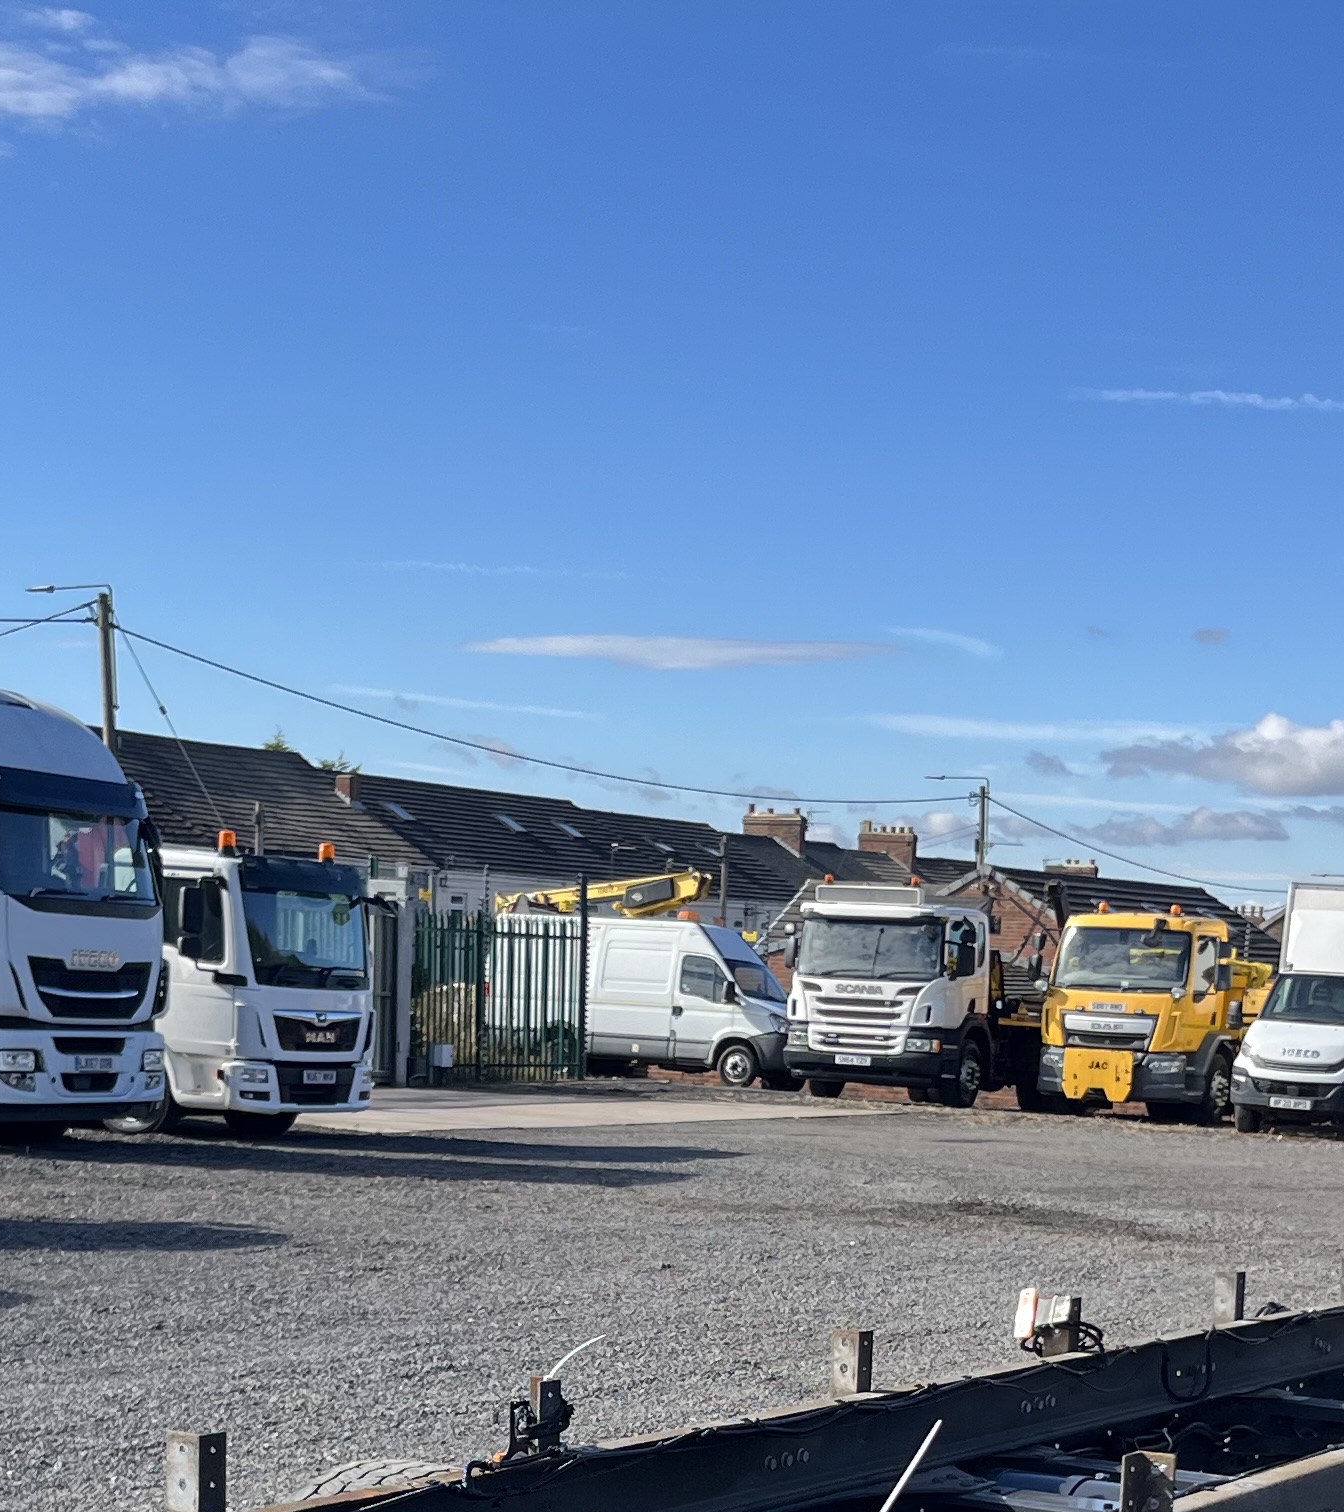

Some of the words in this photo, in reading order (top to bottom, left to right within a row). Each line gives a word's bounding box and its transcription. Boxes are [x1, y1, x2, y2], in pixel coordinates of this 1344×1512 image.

[835, 984, 884, 996] SCANIA
[1090, 1023, 1124, 1031] DAF
[1088, 1061, 1109, 1071] JAC
